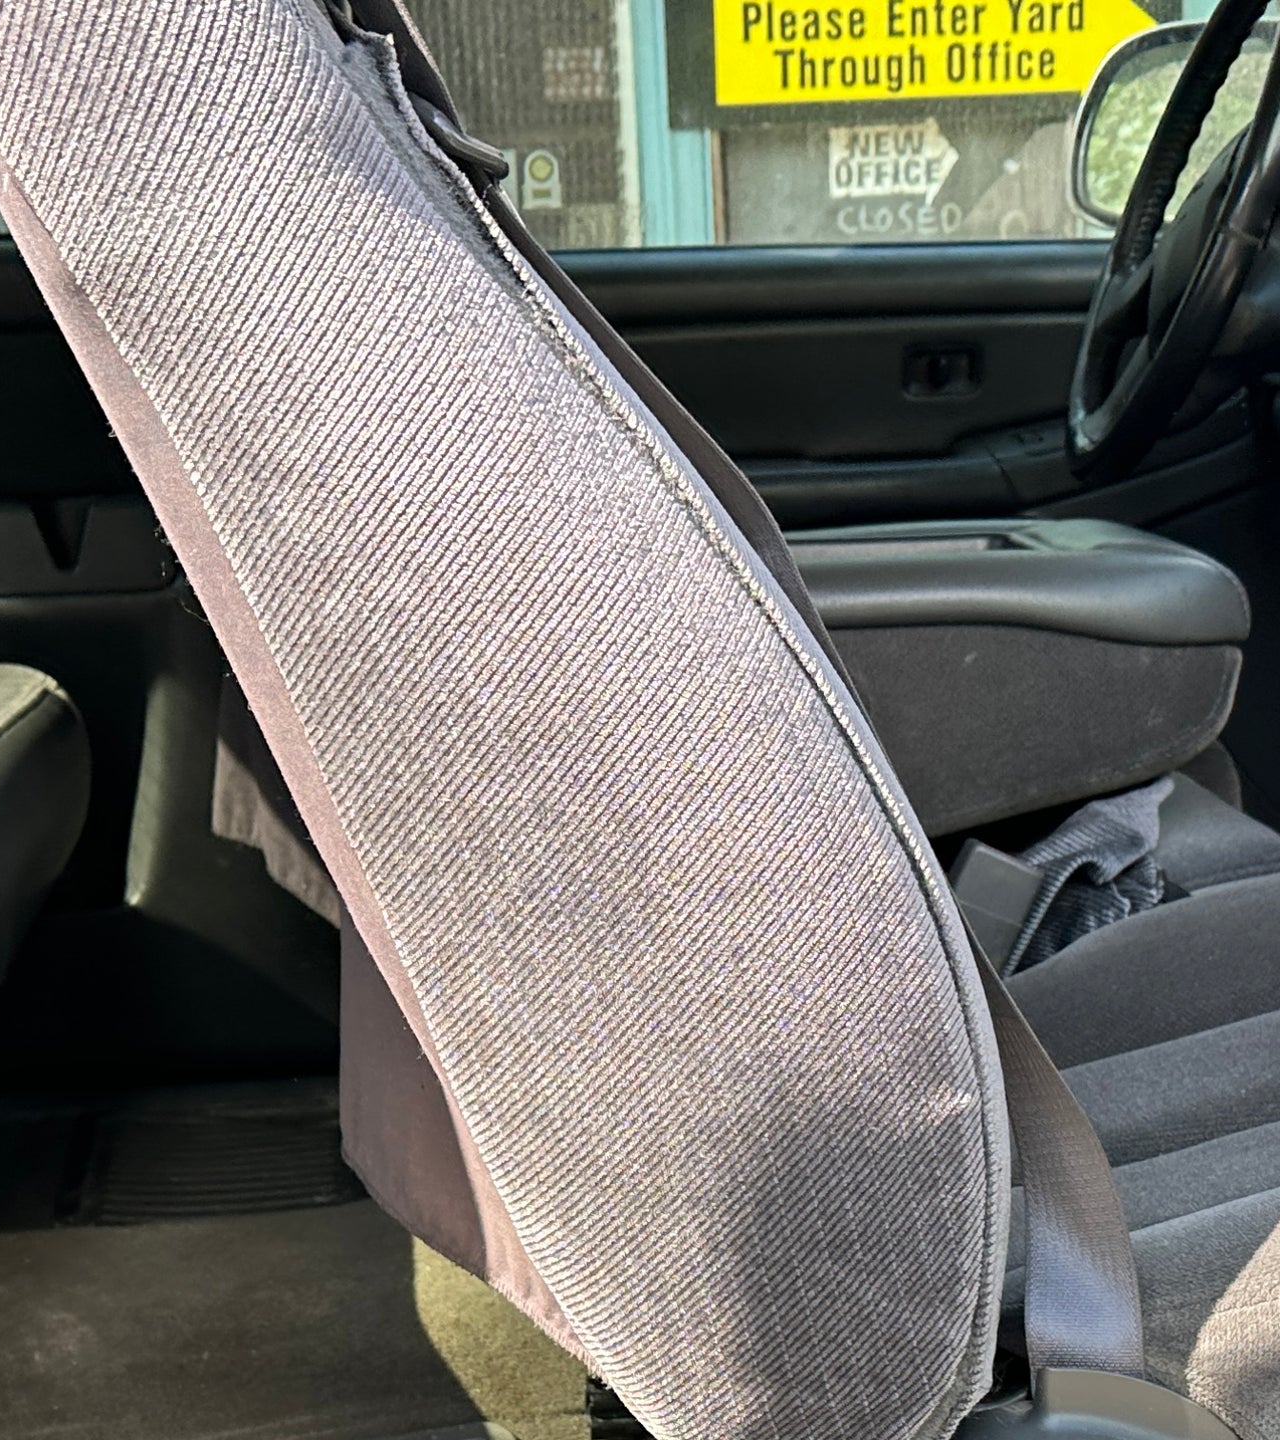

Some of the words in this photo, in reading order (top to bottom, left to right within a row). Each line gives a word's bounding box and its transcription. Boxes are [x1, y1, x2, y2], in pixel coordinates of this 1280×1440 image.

[742, 2, 866, 42] Please
[888, 0, 986, 38] Enter
[1008, 0, 1085, 34] Yard
[774, 44, 926, 93] Through
[946, 40, 1055, 83] Office
[848, 129, 925, 158] NEW
[835, 158, 942, 188] OFFICE
[836, 201, 963, 235] CLOSED
